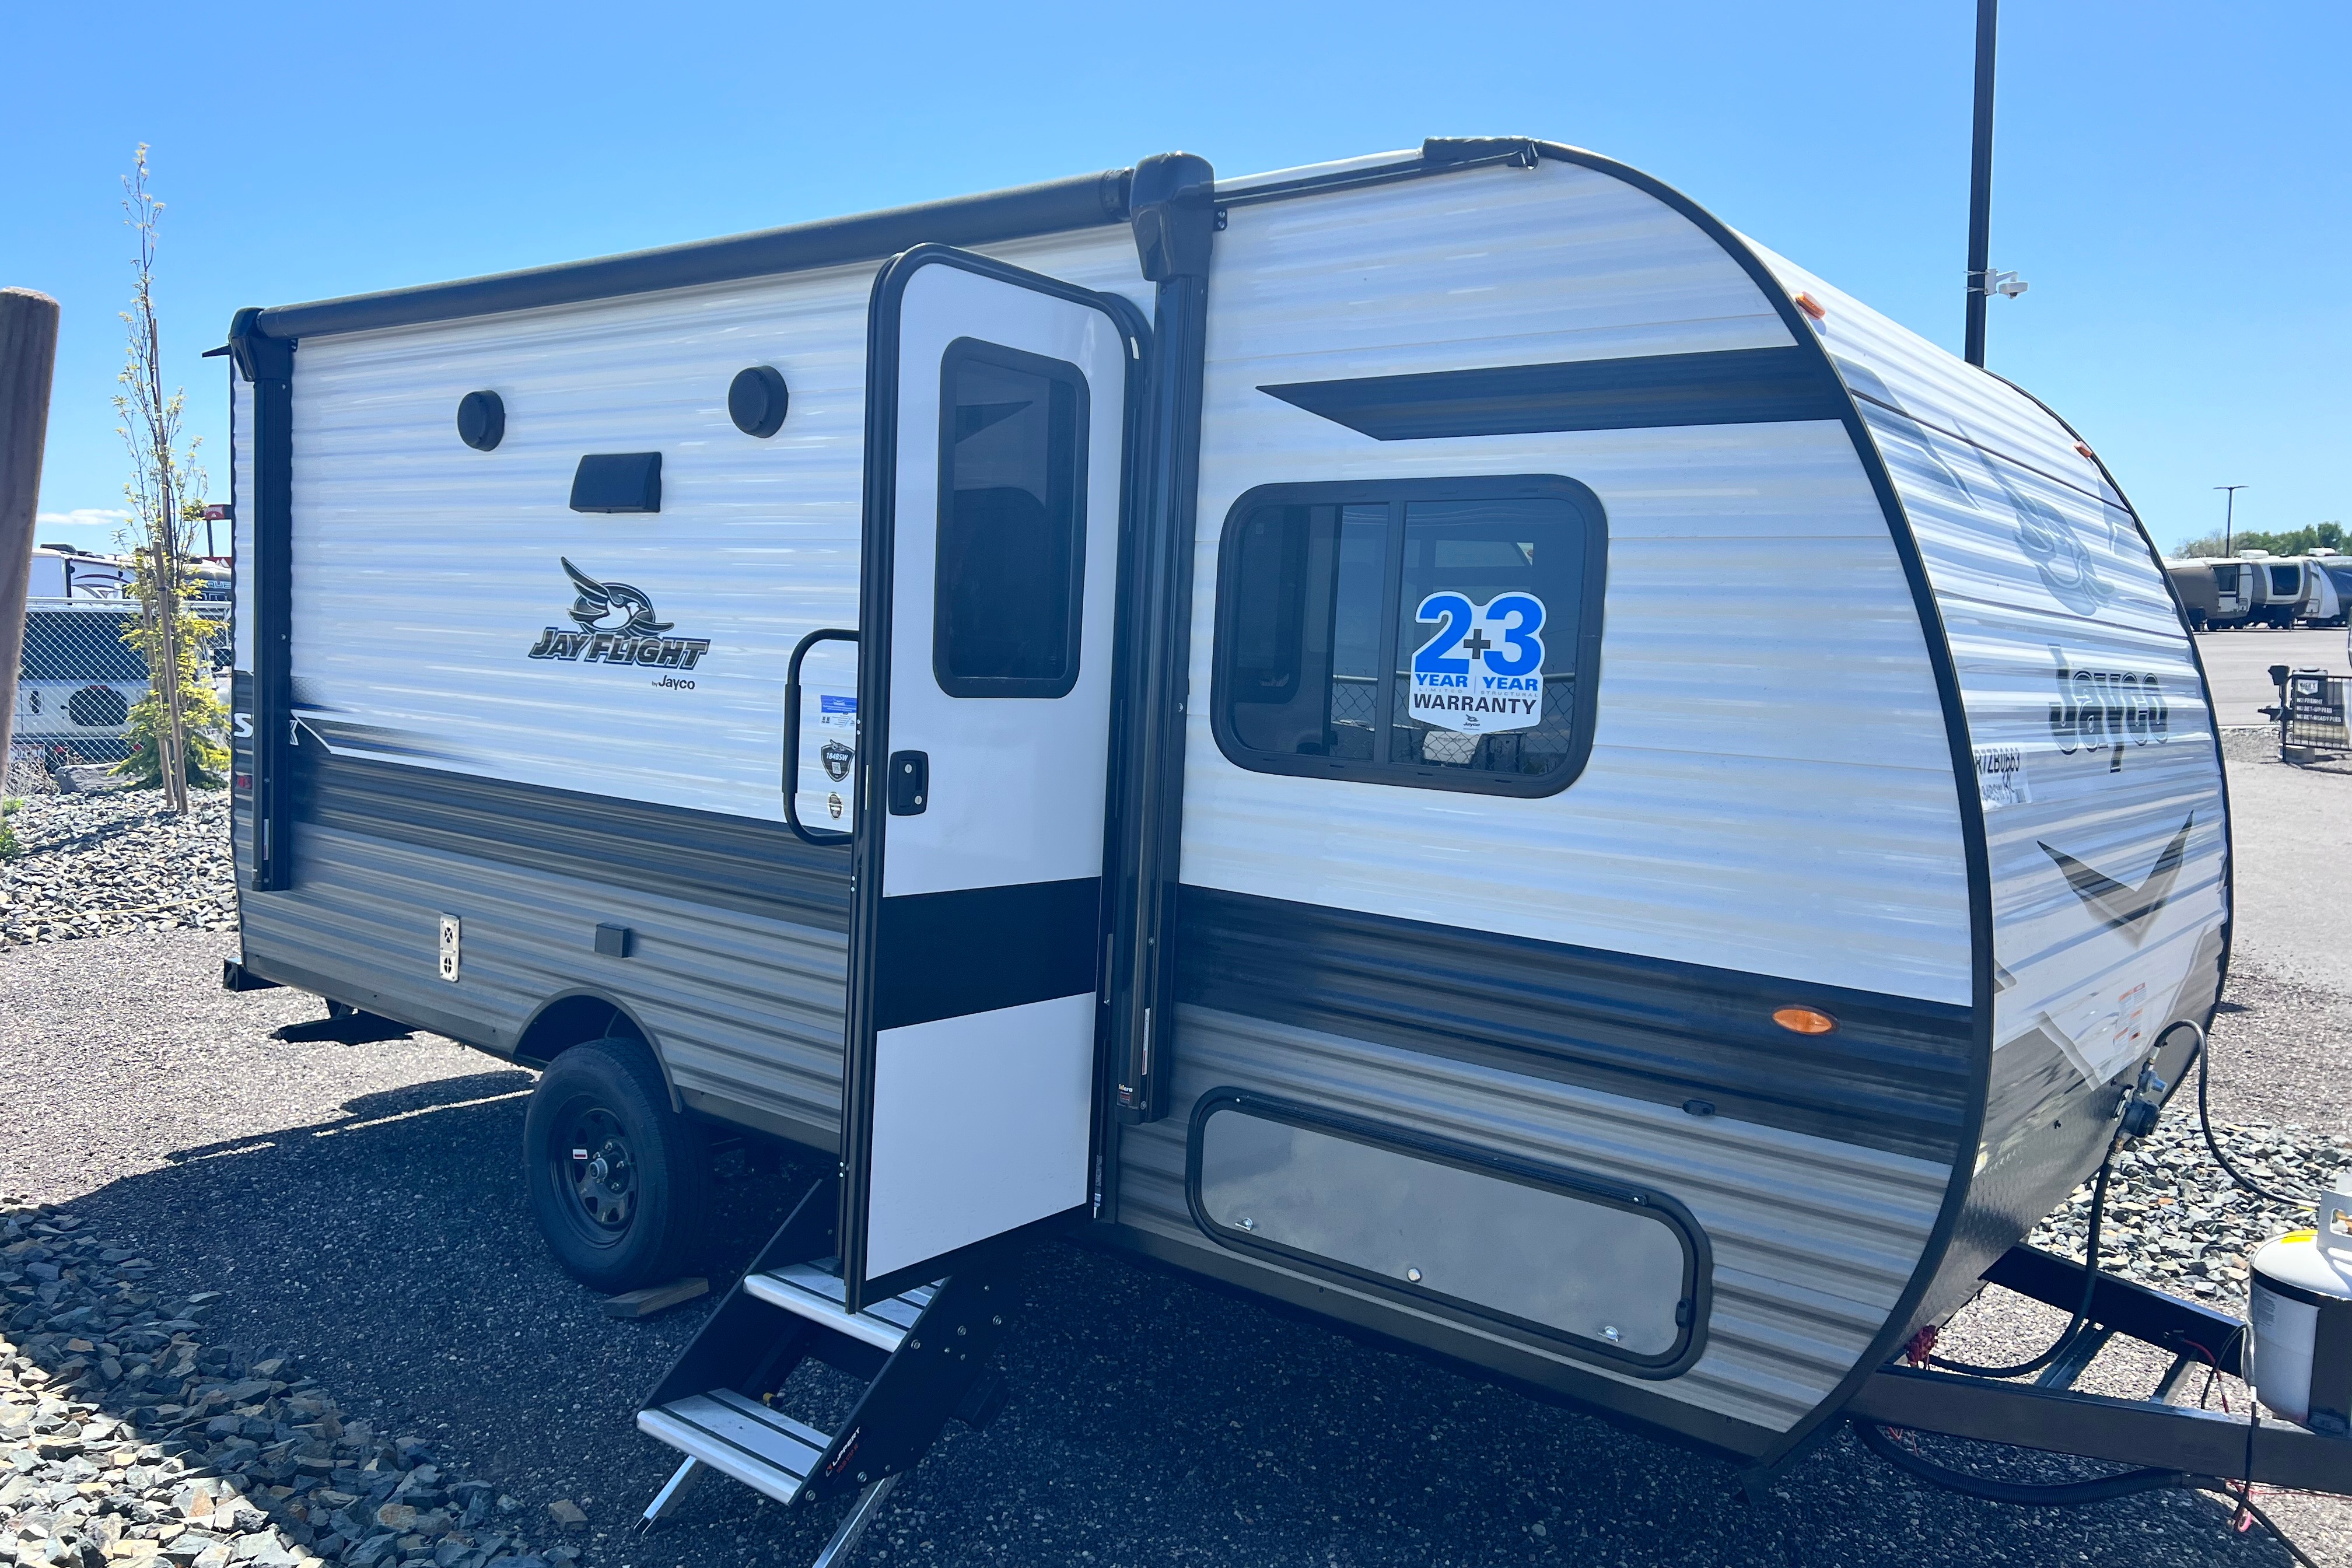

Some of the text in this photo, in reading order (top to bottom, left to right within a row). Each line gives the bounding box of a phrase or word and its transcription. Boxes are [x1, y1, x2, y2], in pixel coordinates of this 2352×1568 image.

[528, 626, 711, 670] JAY FLIGHT
[658, 675, 695, 690] Jayco
[1415, 674, 1538, 691] YEAR YEAR
[1413, 693, 1537, 715] WARRANTY
[2047, 643, 2169, 774] Jayco
[826, 752, 849, 761] 184BSW
